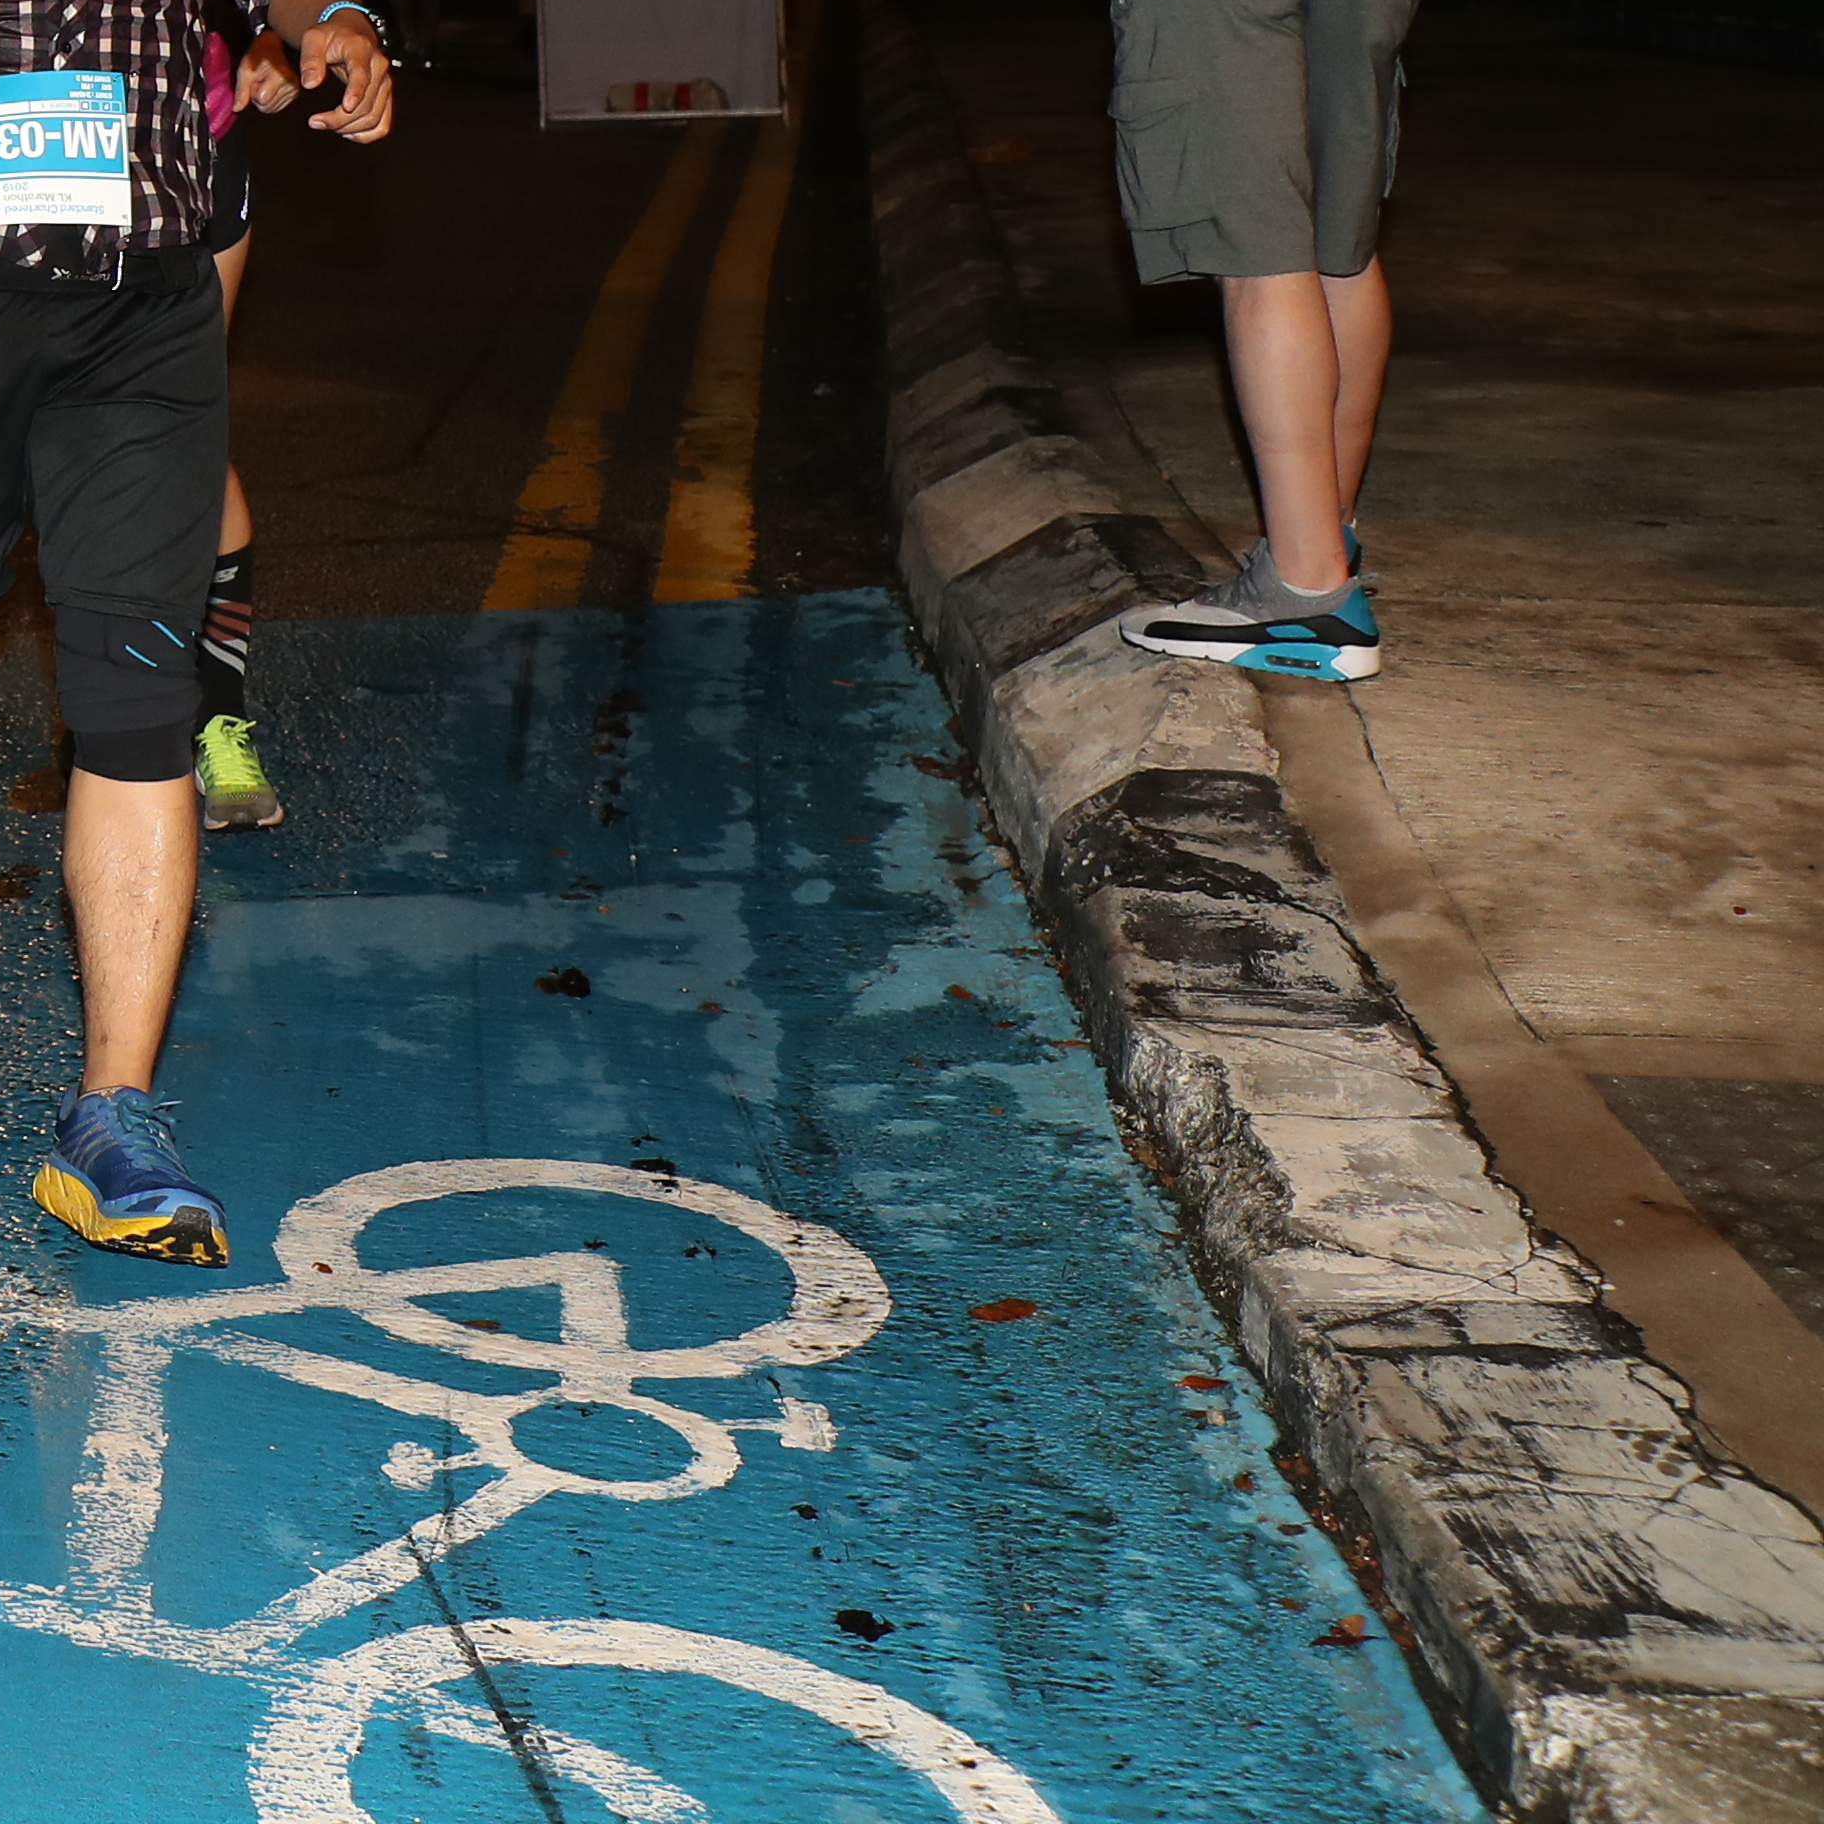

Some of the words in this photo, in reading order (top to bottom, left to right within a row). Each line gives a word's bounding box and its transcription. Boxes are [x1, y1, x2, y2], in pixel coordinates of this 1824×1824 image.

[3, 182, 28, 192] 2019
[4, 193, 55, 202] Marathon
[59, 193, 72, 202] KL
[4, 205, 58, 214] Chartered
[60, 204, 105, 214] Standard
